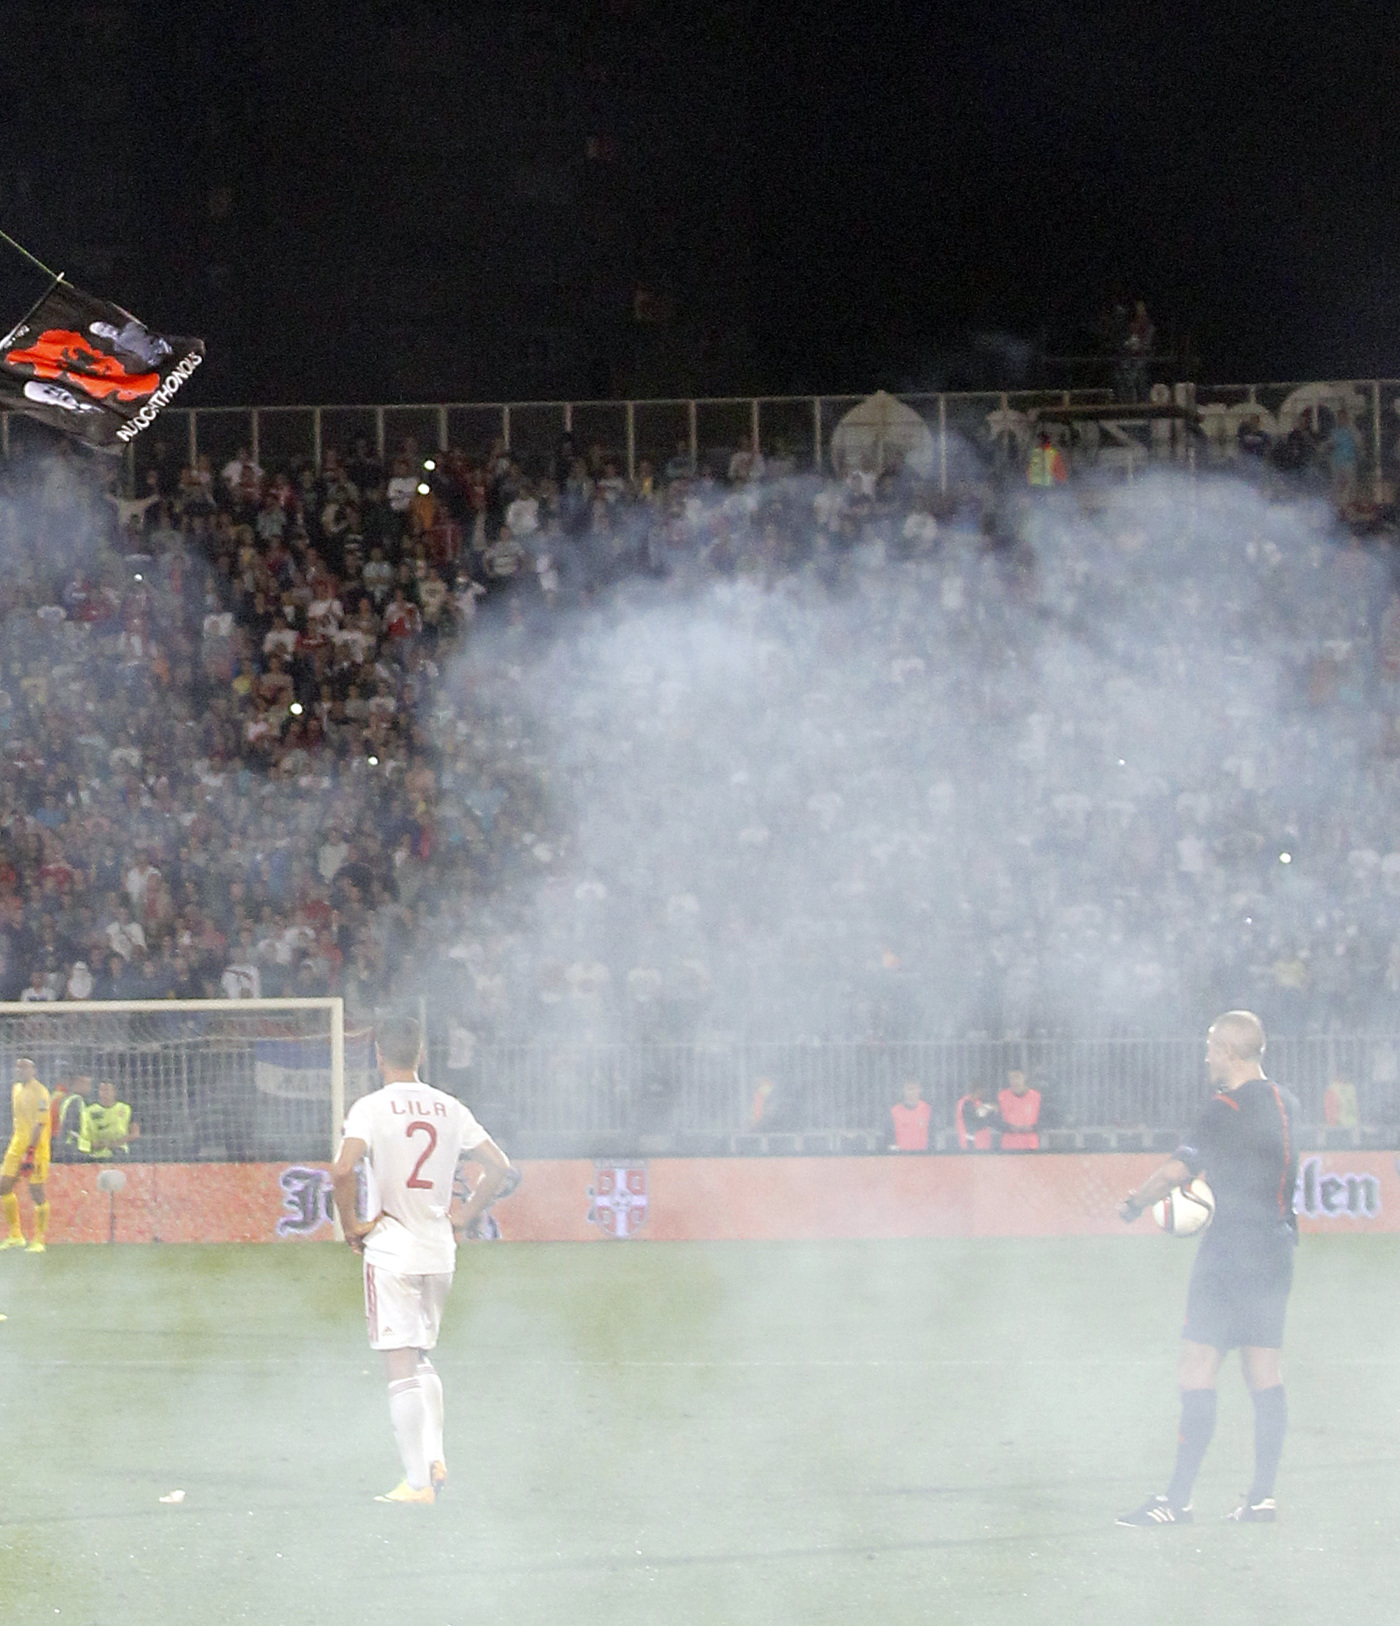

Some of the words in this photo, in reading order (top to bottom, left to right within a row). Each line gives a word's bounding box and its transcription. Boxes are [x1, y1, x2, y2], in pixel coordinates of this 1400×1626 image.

[390, 1099, 448, 1118] LILA
[406, 1121, 437, 1189] 2
[1292, 1156, 1383, 1219] len
